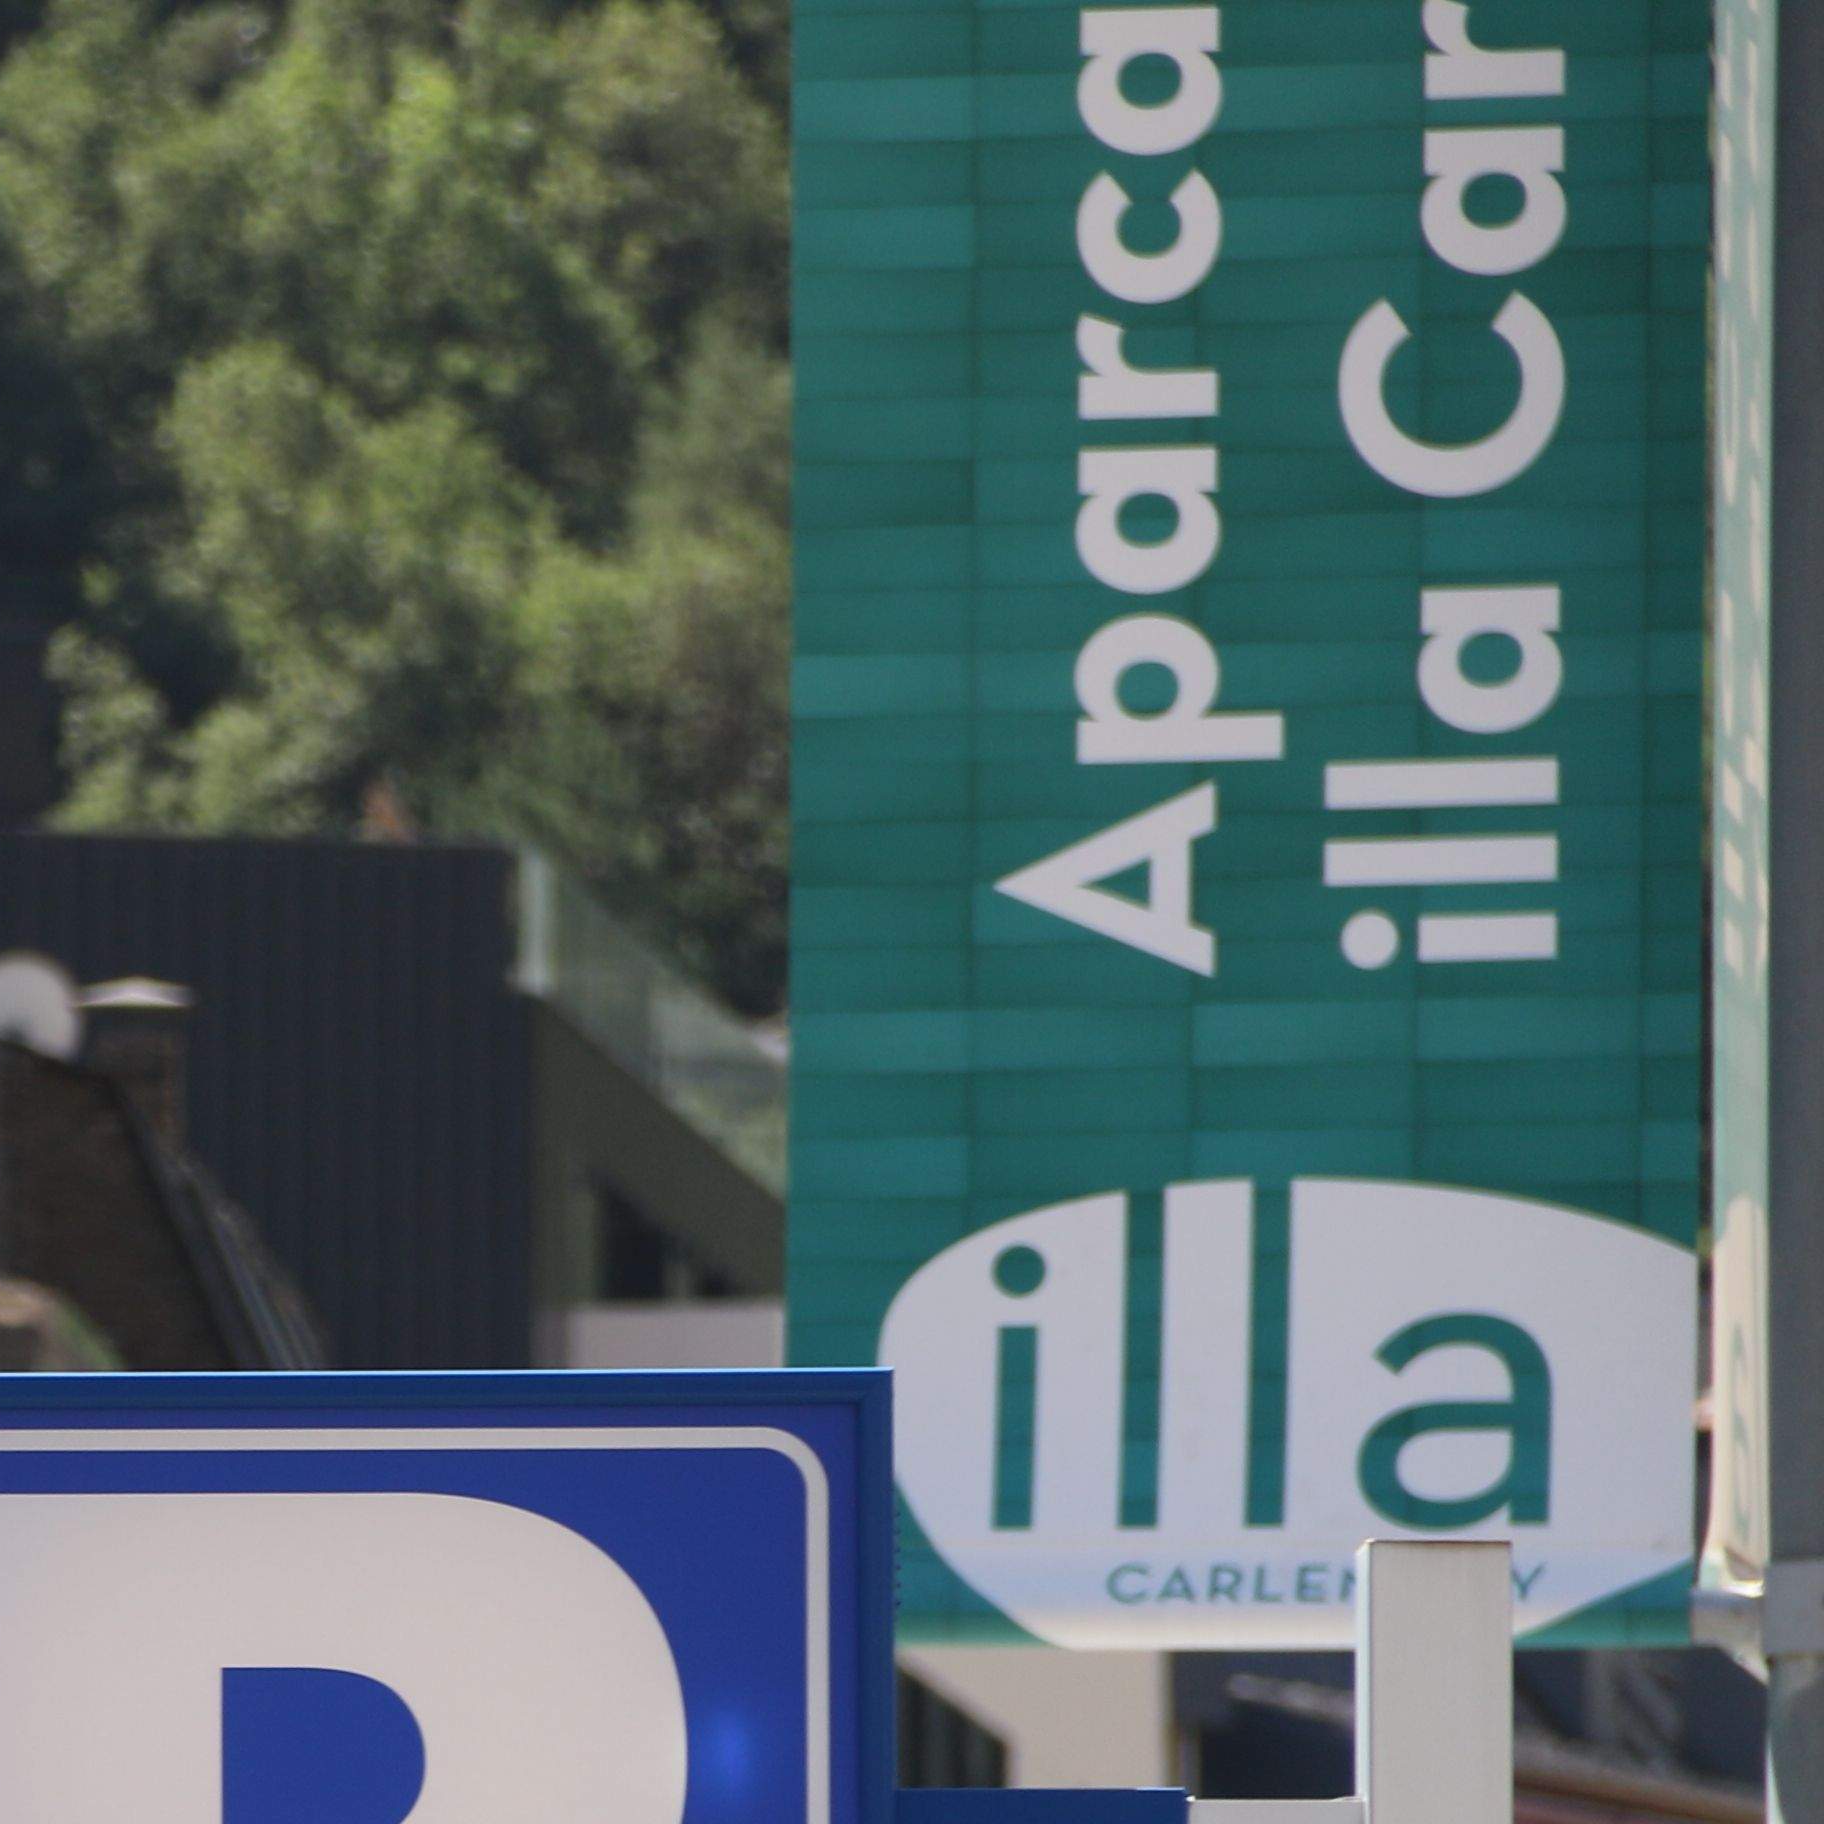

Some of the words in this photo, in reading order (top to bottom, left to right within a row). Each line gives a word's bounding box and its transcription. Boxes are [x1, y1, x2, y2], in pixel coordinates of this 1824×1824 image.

[1337, 0, 1567, 499] Car
[992, 6, 1284, 979] Aparca
[1323, 584, 1563, 970] illa
[991, 1178, 1552, 1533] illa
[1105, 1562, 1545, 1604] CARLEY
